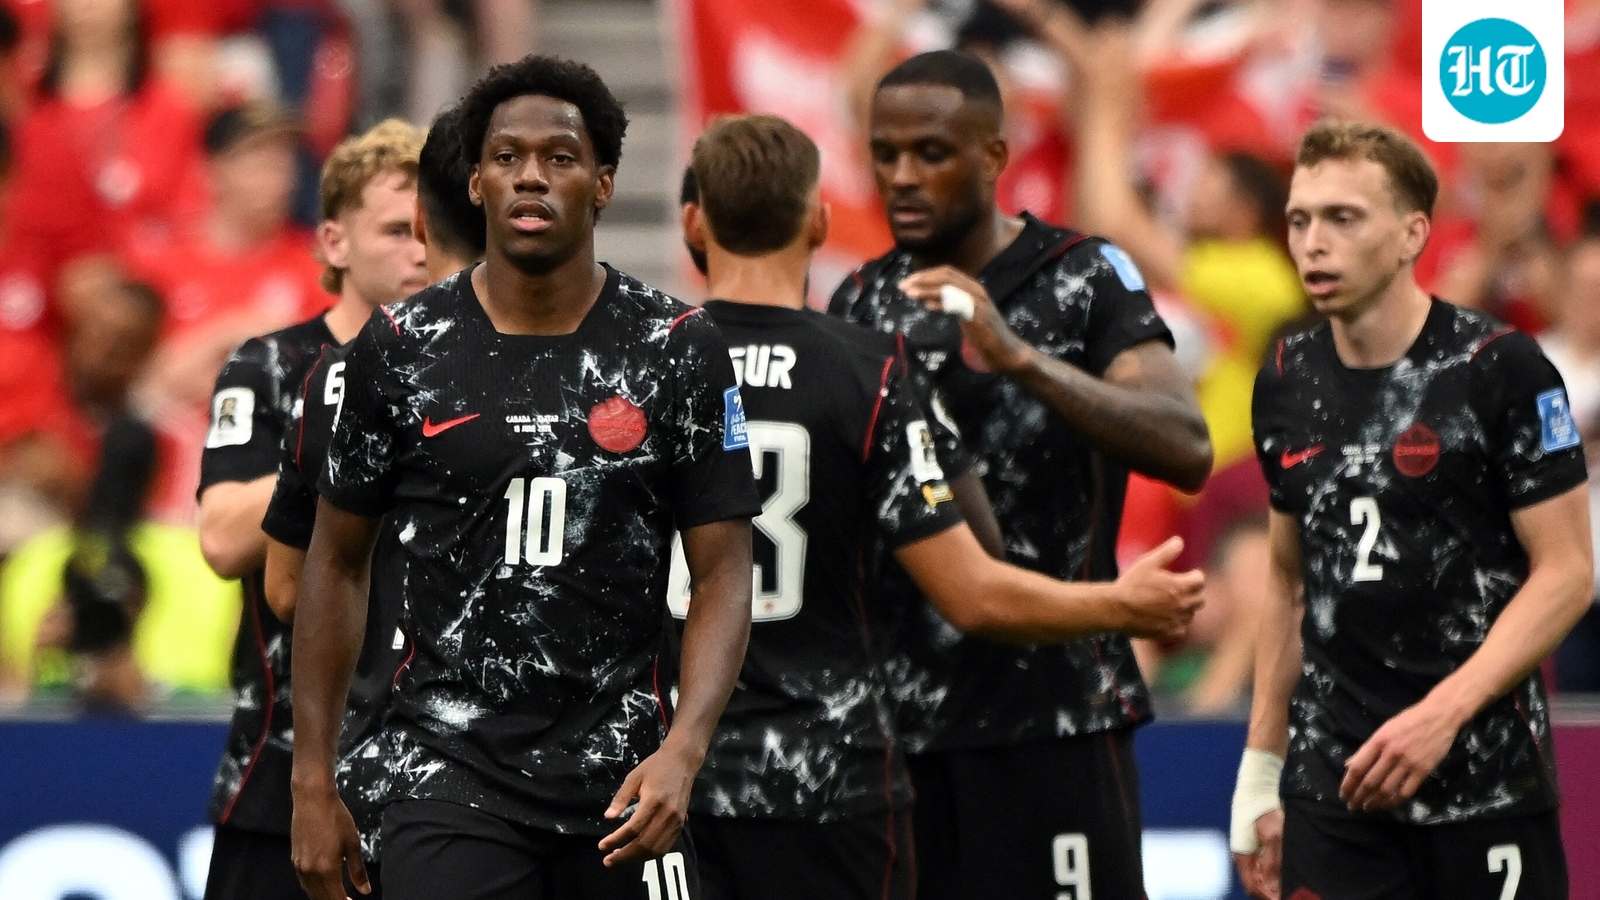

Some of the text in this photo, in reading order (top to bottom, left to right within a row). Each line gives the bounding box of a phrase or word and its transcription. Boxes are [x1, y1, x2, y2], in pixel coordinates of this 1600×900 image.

[503, 476, 567, 567] 10
[666, 419, 811, 623] 3
[1349, 496, 1383, 582] 2
[641, 851, 691, 900] 10
[1051, 832, 1092, 900] 9
[1486, 843, 1523, 900] 2
